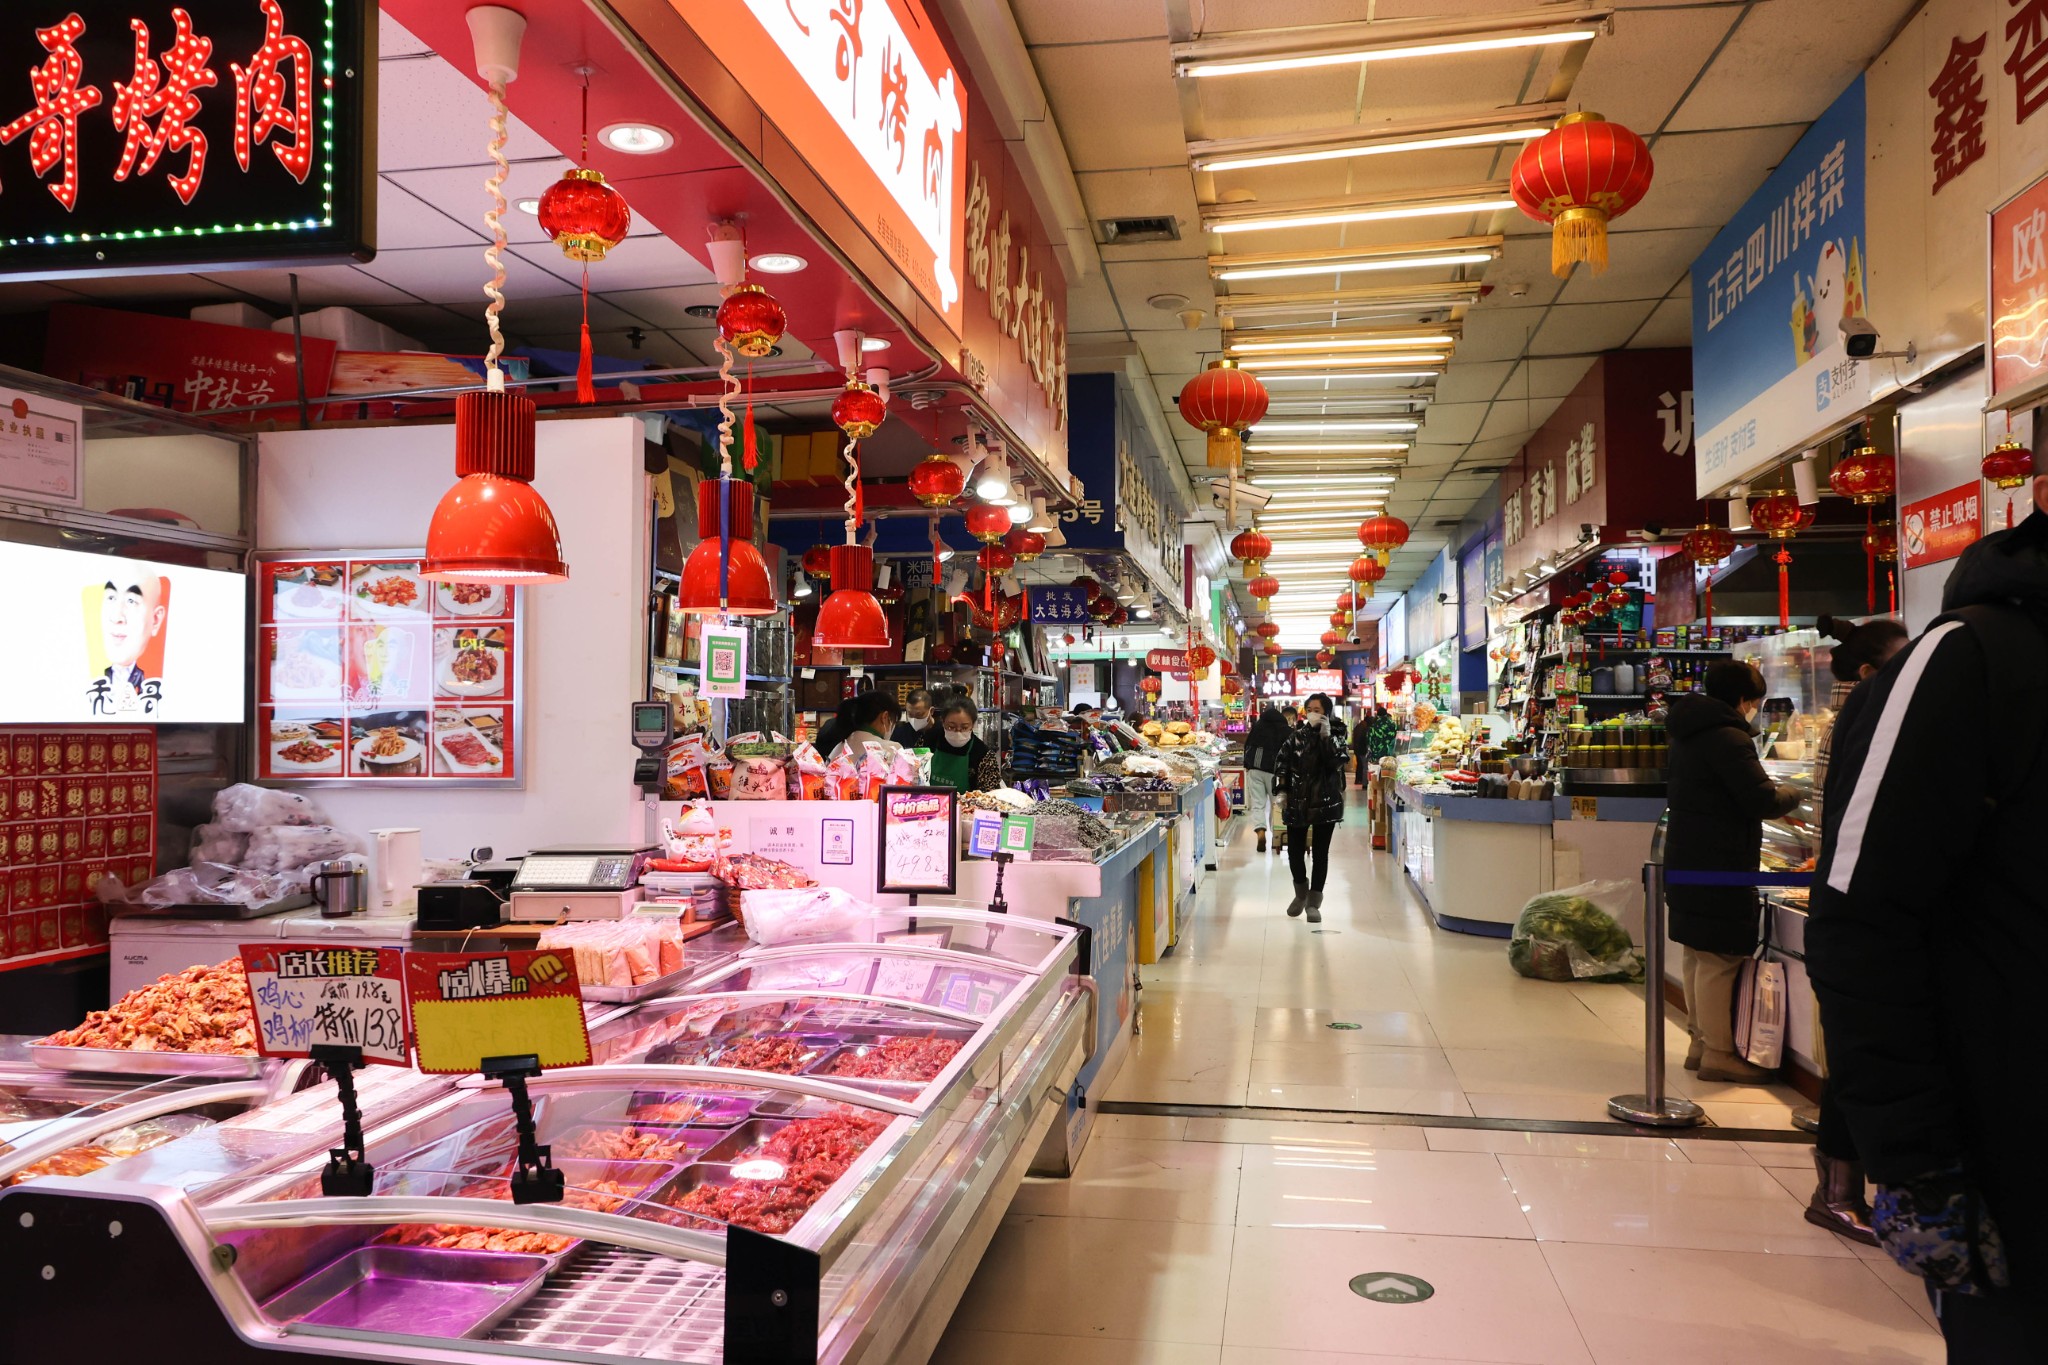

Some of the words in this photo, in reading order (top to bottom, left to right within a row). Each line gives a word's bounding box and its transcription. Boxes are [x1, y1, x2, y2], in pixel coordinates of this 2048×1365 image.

[1707, 139, 1847, 333] 正宗四川拌菜
[1831, 358, 1860, 389] 支付宝
[183, 370, 275, 422] 中秋节
[1832, 379, 1858, 401] ALIPAY
[1704, 436, 1729, 474] 生活好
[1730, 418, 1757, 459] 支付宝
[1057, 500, 1104, 524] 5号
[1929, 495, 1978, 533] 禁止吸烟
[1034, 603, 1085, 619] 大连海参
[1046, 591, 1074, 602] 批发
[892, 798, 940, 816] 特价商品
[769, 826, 795, 836] 诚聘
[278, 950, 378, 977] 店长推荐
[438, 957, 530, 1000] 惊爆价
[257, 977, 306, 1010] 鸡心
[263, 1011, 315, 1048] 鸡柳
[313, 1002, 360, 1045] 特价
[1376, 1292, 1408, 1300] EXIT
